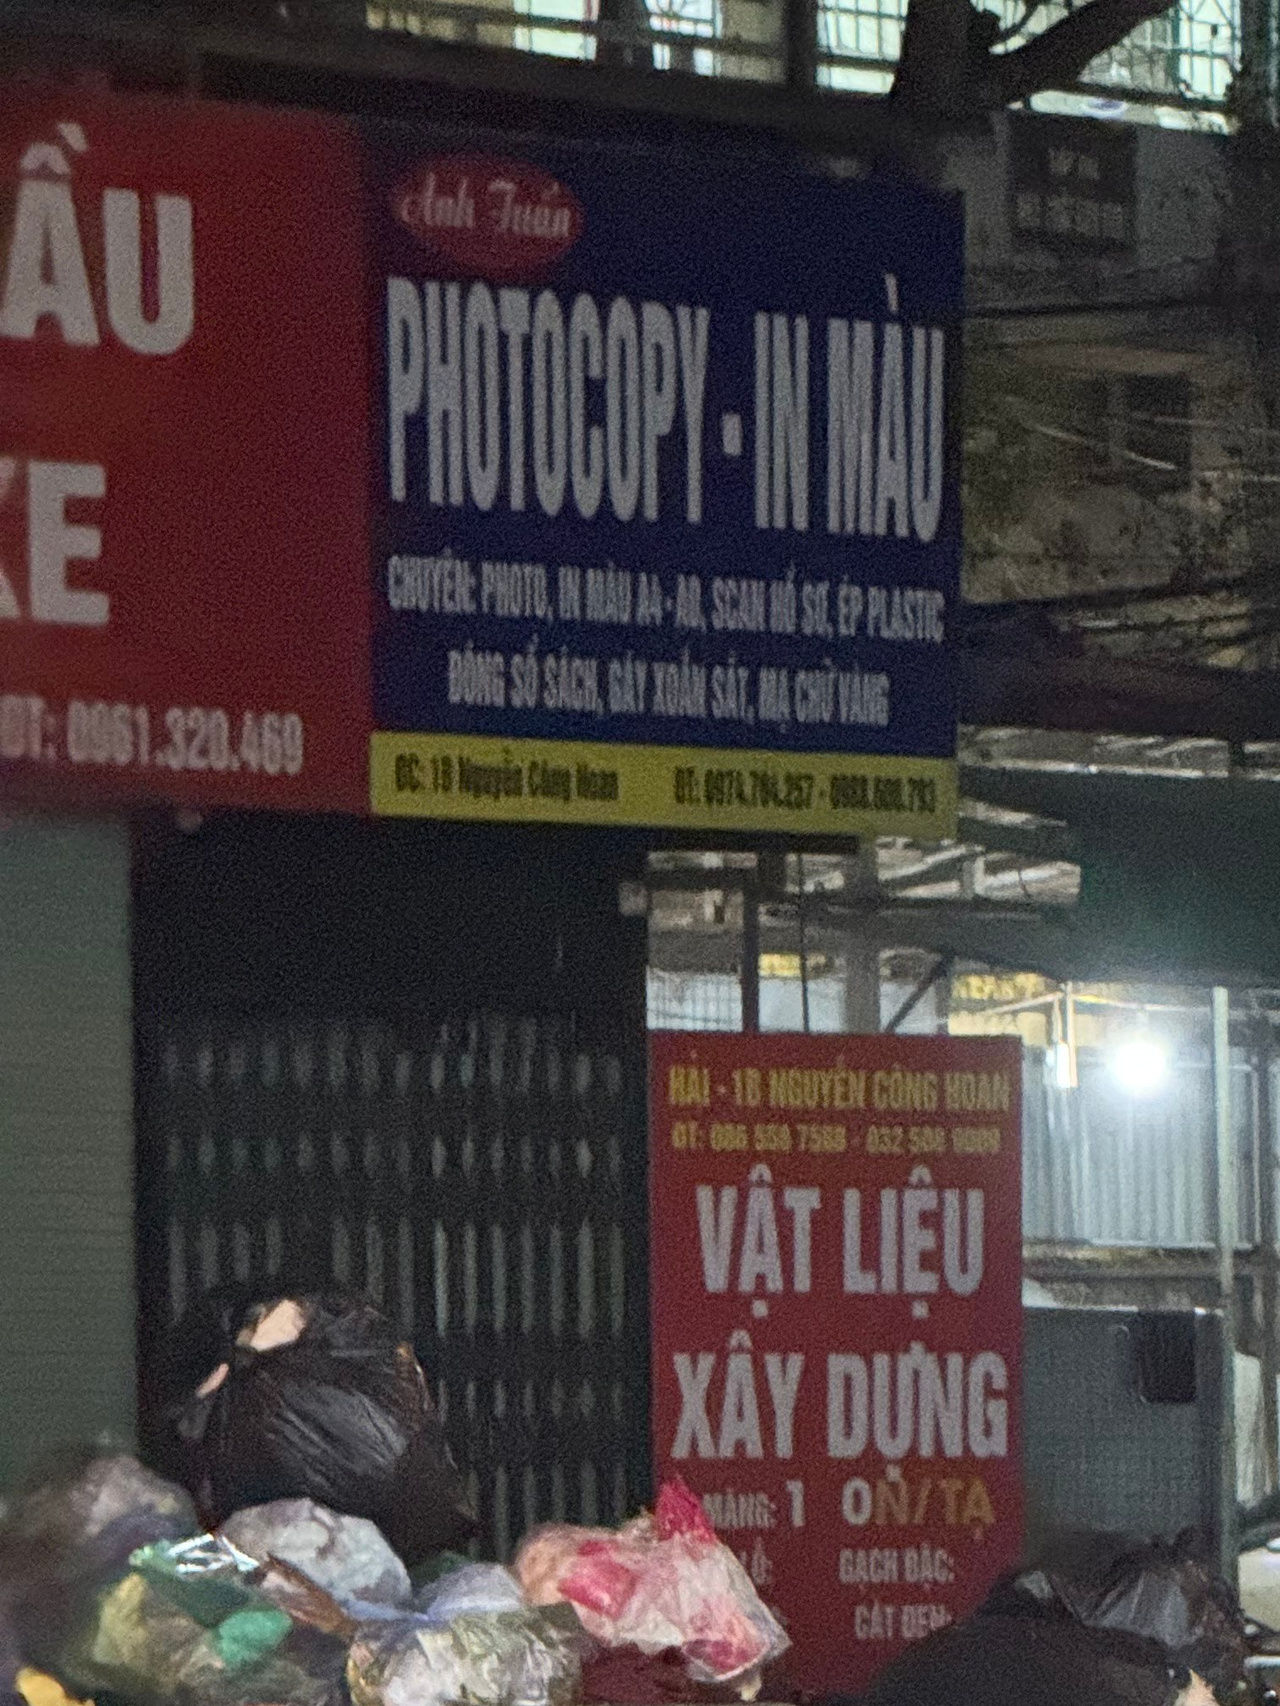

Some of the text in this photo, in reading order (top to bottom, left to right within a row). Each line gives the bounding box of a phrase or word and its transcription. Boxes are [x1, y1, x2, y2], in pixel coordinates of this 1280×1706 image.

[387, 275, 711, 524] PHOTOCOPY
[754, 310, 809, 532] IN
[827, 272, 944, 543] MÀU
[711, 576, 766, 632] SCAN
[867, 585, 946, 645] PLASTIC
[696, 1162, 986, 1320] VẬT LIỆU
[671, 1328, 1010, 1482] XÂY DỰNG
